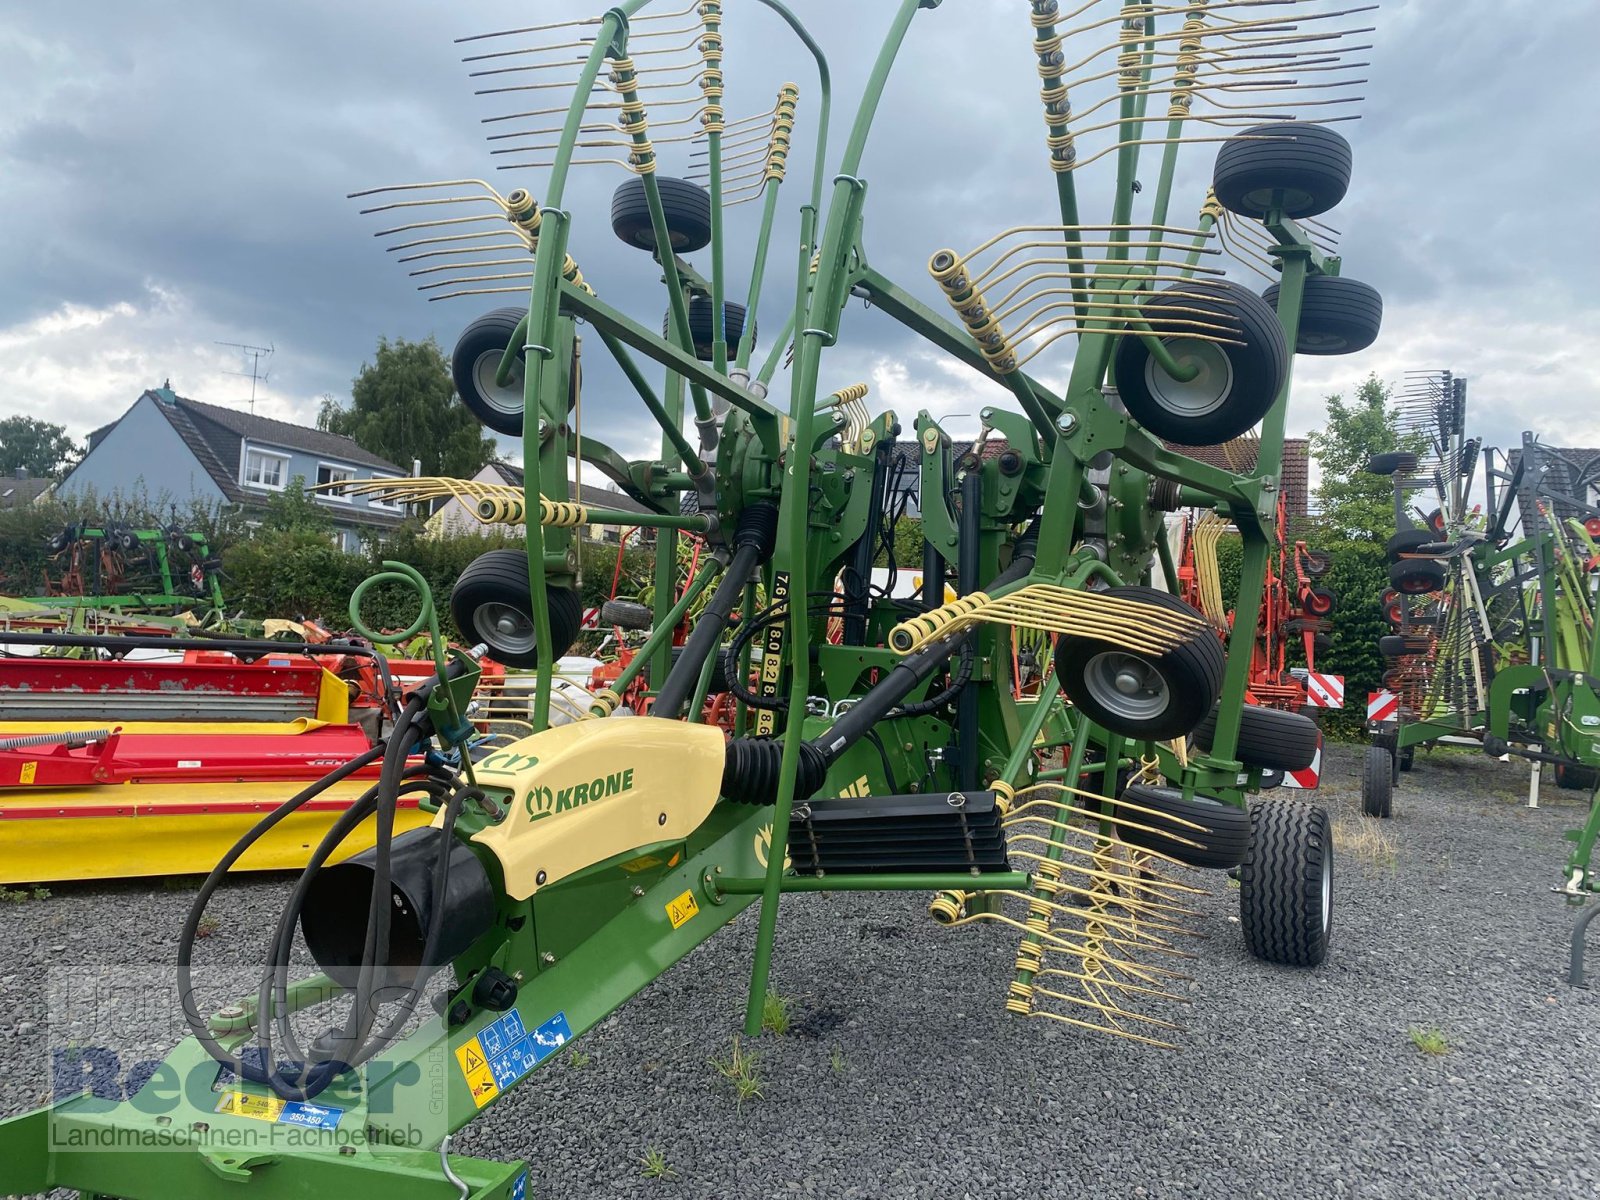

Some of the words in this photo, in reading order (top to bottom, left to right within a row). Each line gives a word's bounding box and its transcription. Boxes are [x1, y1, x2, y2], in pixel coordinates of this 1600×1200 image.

[775, 575, 789, 596] 7.6
[768, 629, 781, 651] 8.0
[765, 658, 778, 679] 8.2
[759, 713, 772, 735] 8.6
[555, 768, 634, 814] KRONE
